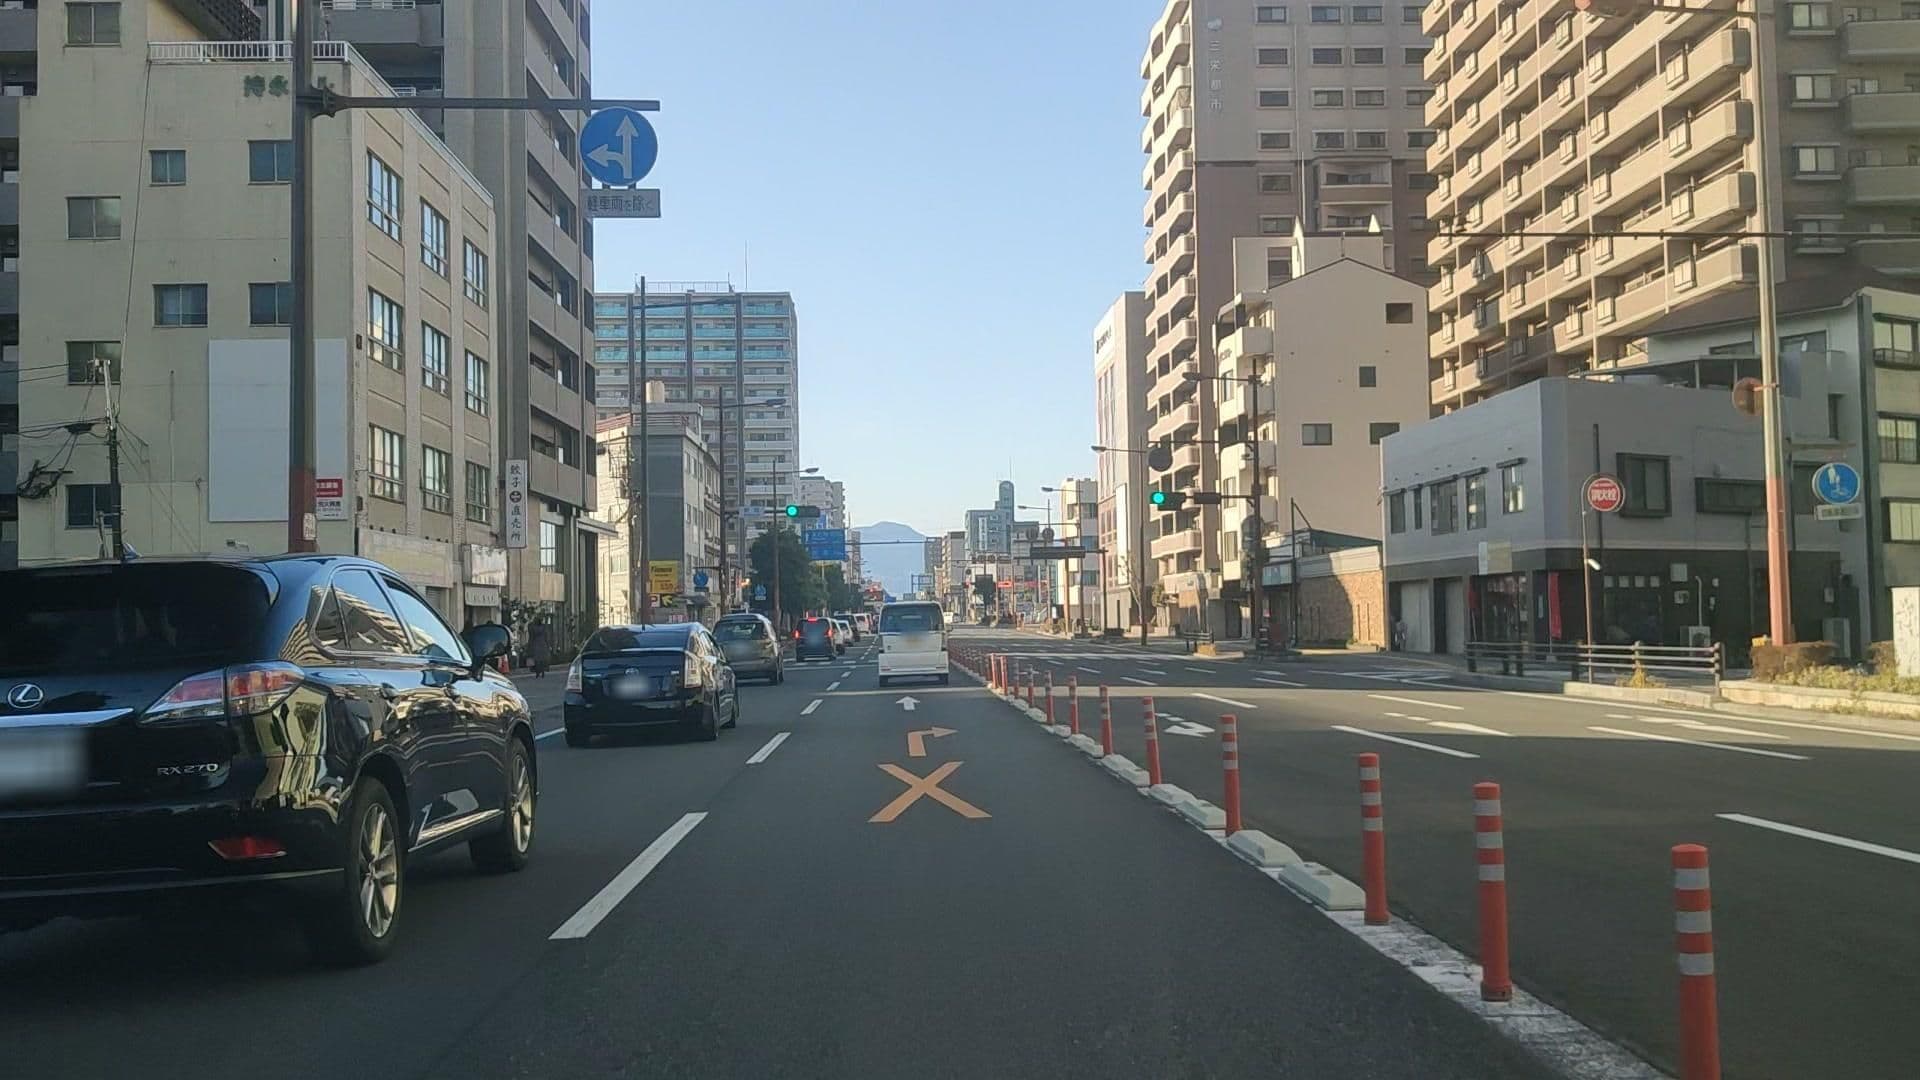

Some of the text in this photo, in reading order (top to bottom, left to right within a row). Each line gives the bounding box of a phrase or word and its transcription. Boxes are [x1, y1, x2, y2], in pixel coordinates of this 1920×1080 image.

[588, 195, 655, 211] 軽車両を除く
[1591, 488, 1617, 501] 消火栓
[157, 763, 218, 775] RX 270
